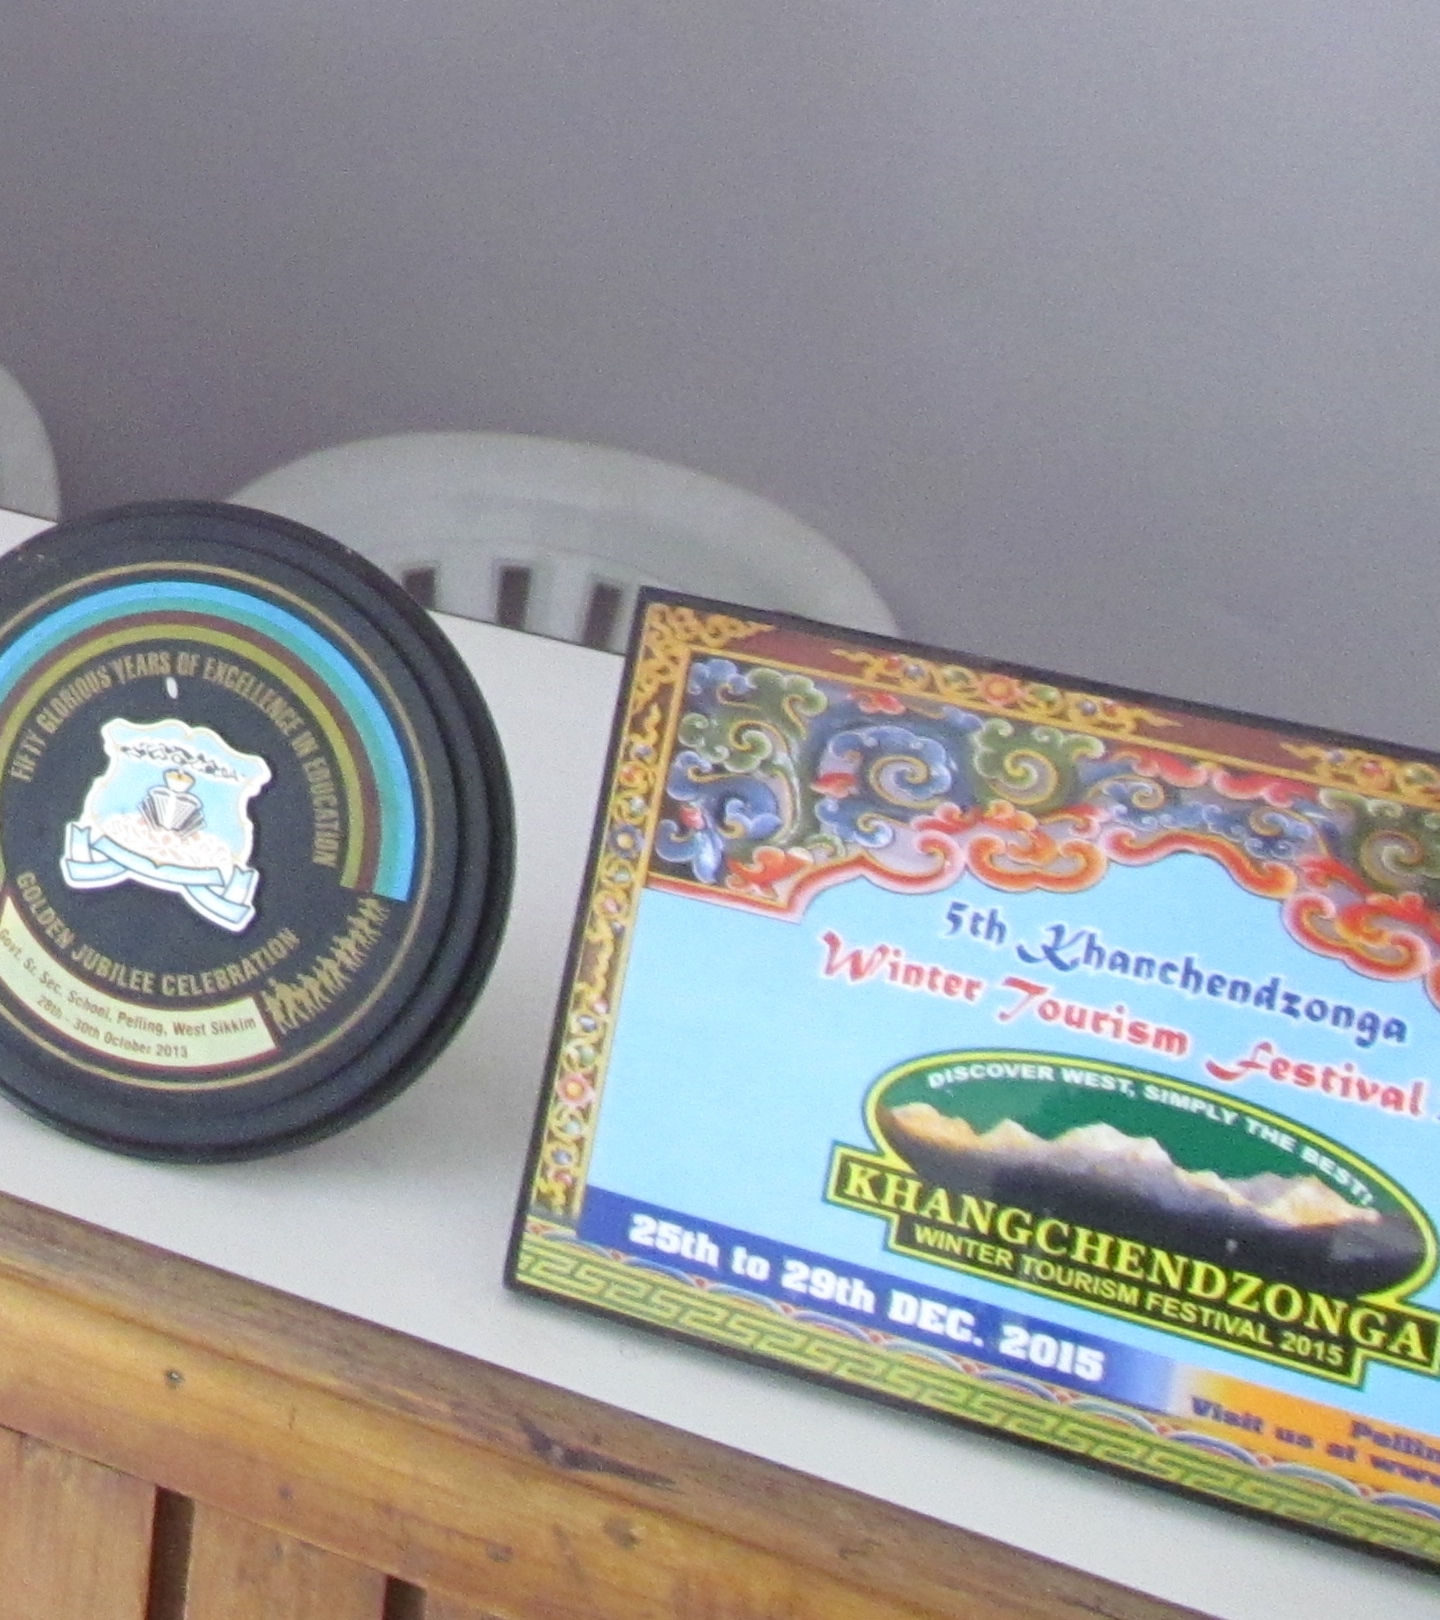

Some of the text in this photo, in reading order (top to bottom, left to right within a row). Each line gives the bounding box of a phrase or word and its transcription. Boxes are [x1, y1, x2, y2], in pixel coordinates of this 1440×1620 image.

[10, 728, 48, 783] FIFTY
[35, 665, 114, 734] GLORIOUS
[108, 650, 171, 685] YEARS
[176, 651, 201, 677] OF
[202, 656, 305, 737] EXCELLENCE
[302, 756, 340, 869] EDUCATION
[16, 871, 302, 998] GOLDEN JUBILEE CELEBRATION
[945, 900, 1409, 1049] 5th Khanchendzonga
[72, 1017, 102, 1041] 30th
[102, 1030, 153, 1056] October
[155, 1042, 190, 1060] 2013
[172, 1019, 208, 1038] West
[210, 1016, 258, 1036] Sikkim
[822, 930, 1425, 1118] Winter Tourism Festival
[926, 1061, 1056, 1091] DISCOVER
[1061, 1065, 1137, 1099] WEST,
[1142, 1083, 1240, 1127] SIMPLY
[1244, 1117, 1298, 1154] THE
[628, 1212, 1107, 1382] 25th to 29th DEC. 2015
[843, 1160, 1430, 1362] KHANGCHENDZONGA
[913, 1222, 1345, 1368] WINTER TOURISM FESTIVAL 2015
